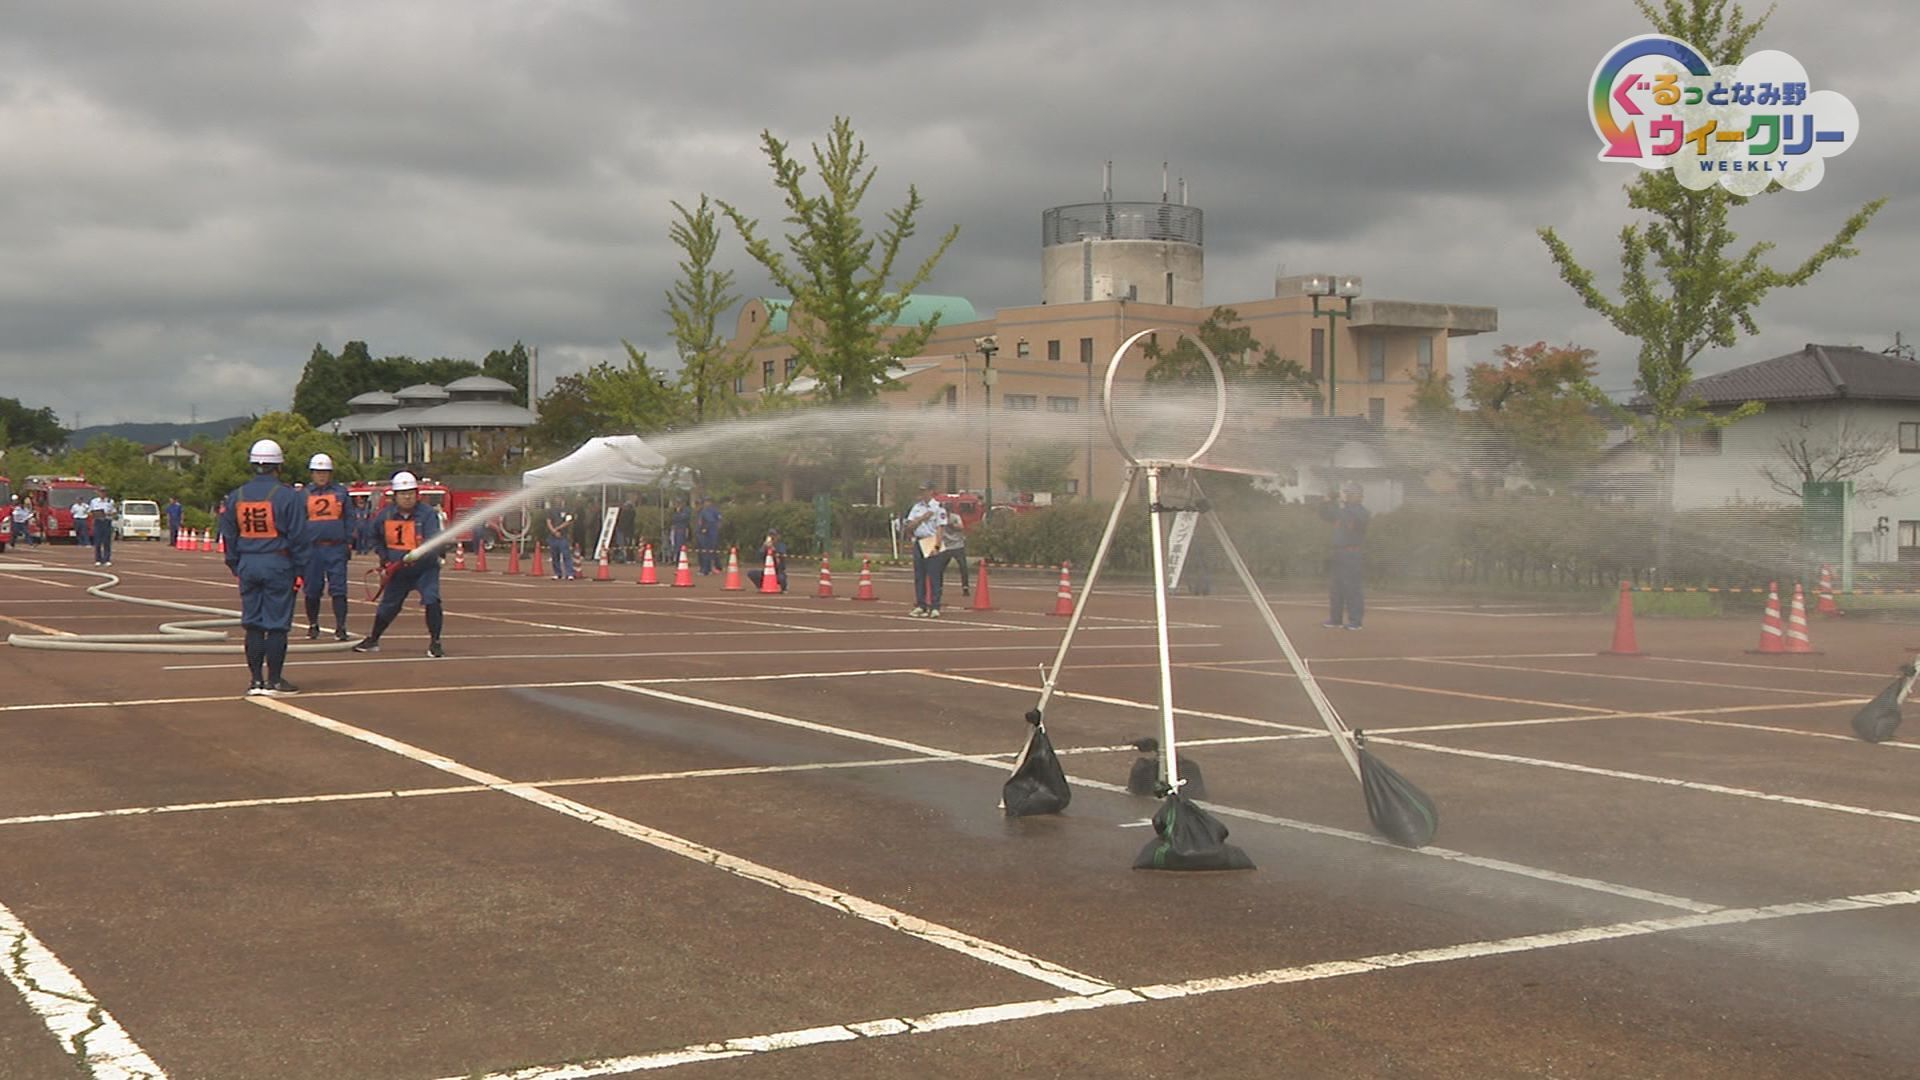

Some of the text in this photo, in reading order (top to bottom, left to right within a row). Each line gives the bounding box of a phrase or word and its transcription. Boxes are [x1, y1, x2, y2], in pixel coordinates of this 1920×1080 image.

[315, 500, 332, 516] 2
[242, 508, 269, 533] 指
[394, 525, 405, 546] 1
